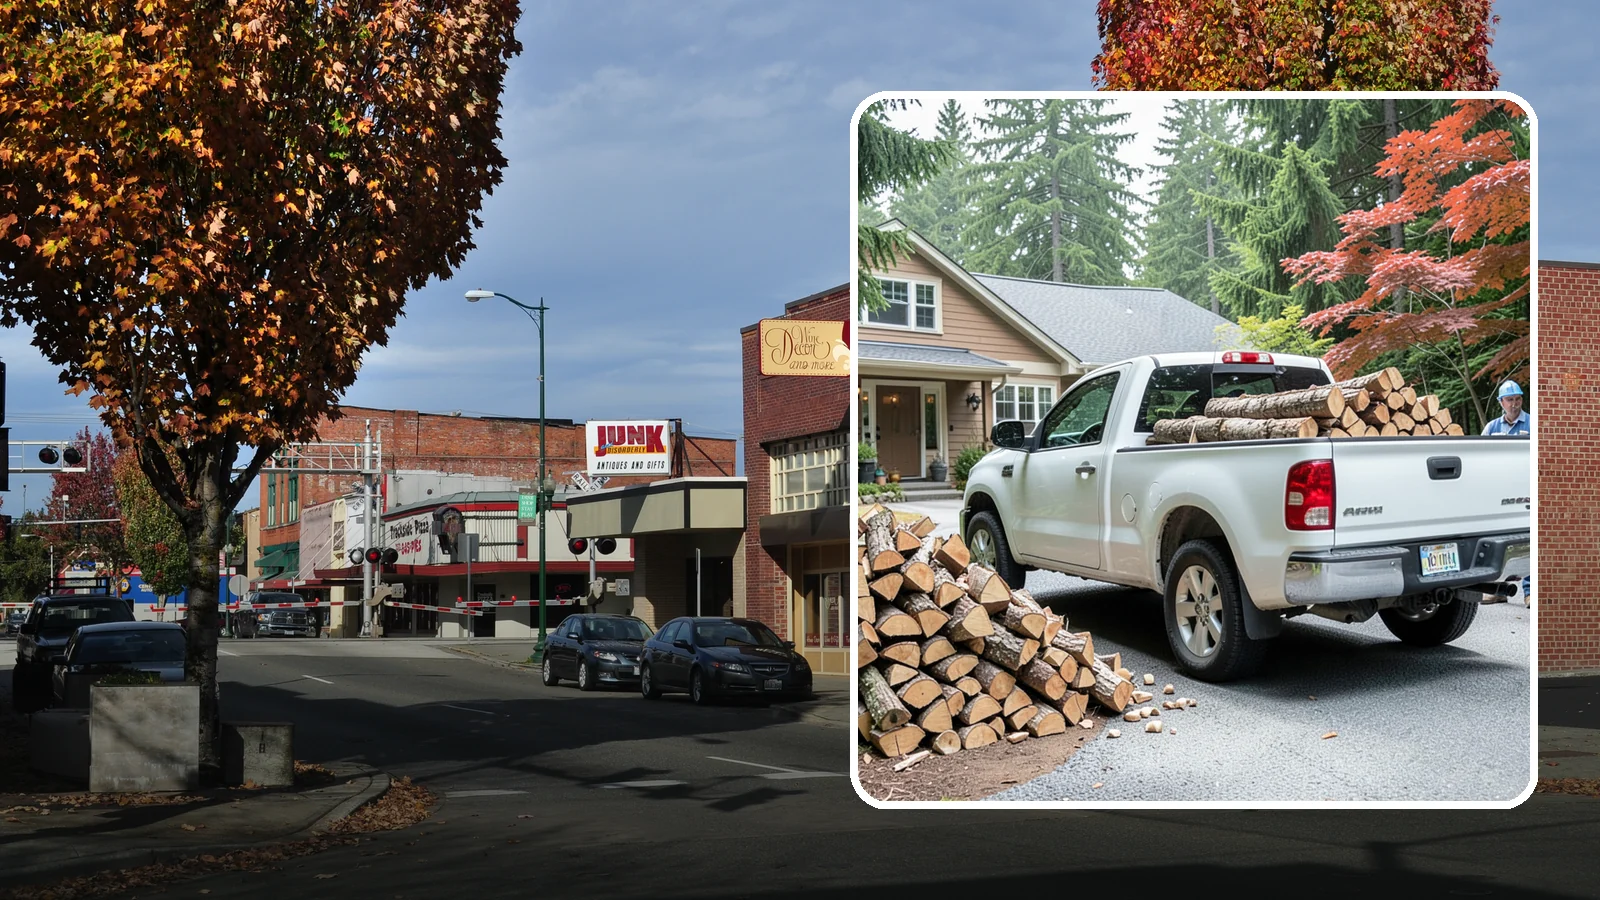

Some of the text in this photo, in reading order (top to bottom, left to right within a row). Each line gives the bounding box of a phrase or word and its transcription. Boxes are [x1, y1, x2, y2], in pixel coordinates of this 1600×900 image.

[764, 327, 831, 365] Decor
[595, 425, 664, 457] JUNK
[607, 446, 646, 454] DISORDERLY
[597, 460, 665, 470] ANTIQUES AND GIFTS
[390, 519, 429, 540] Trackside Pizza
